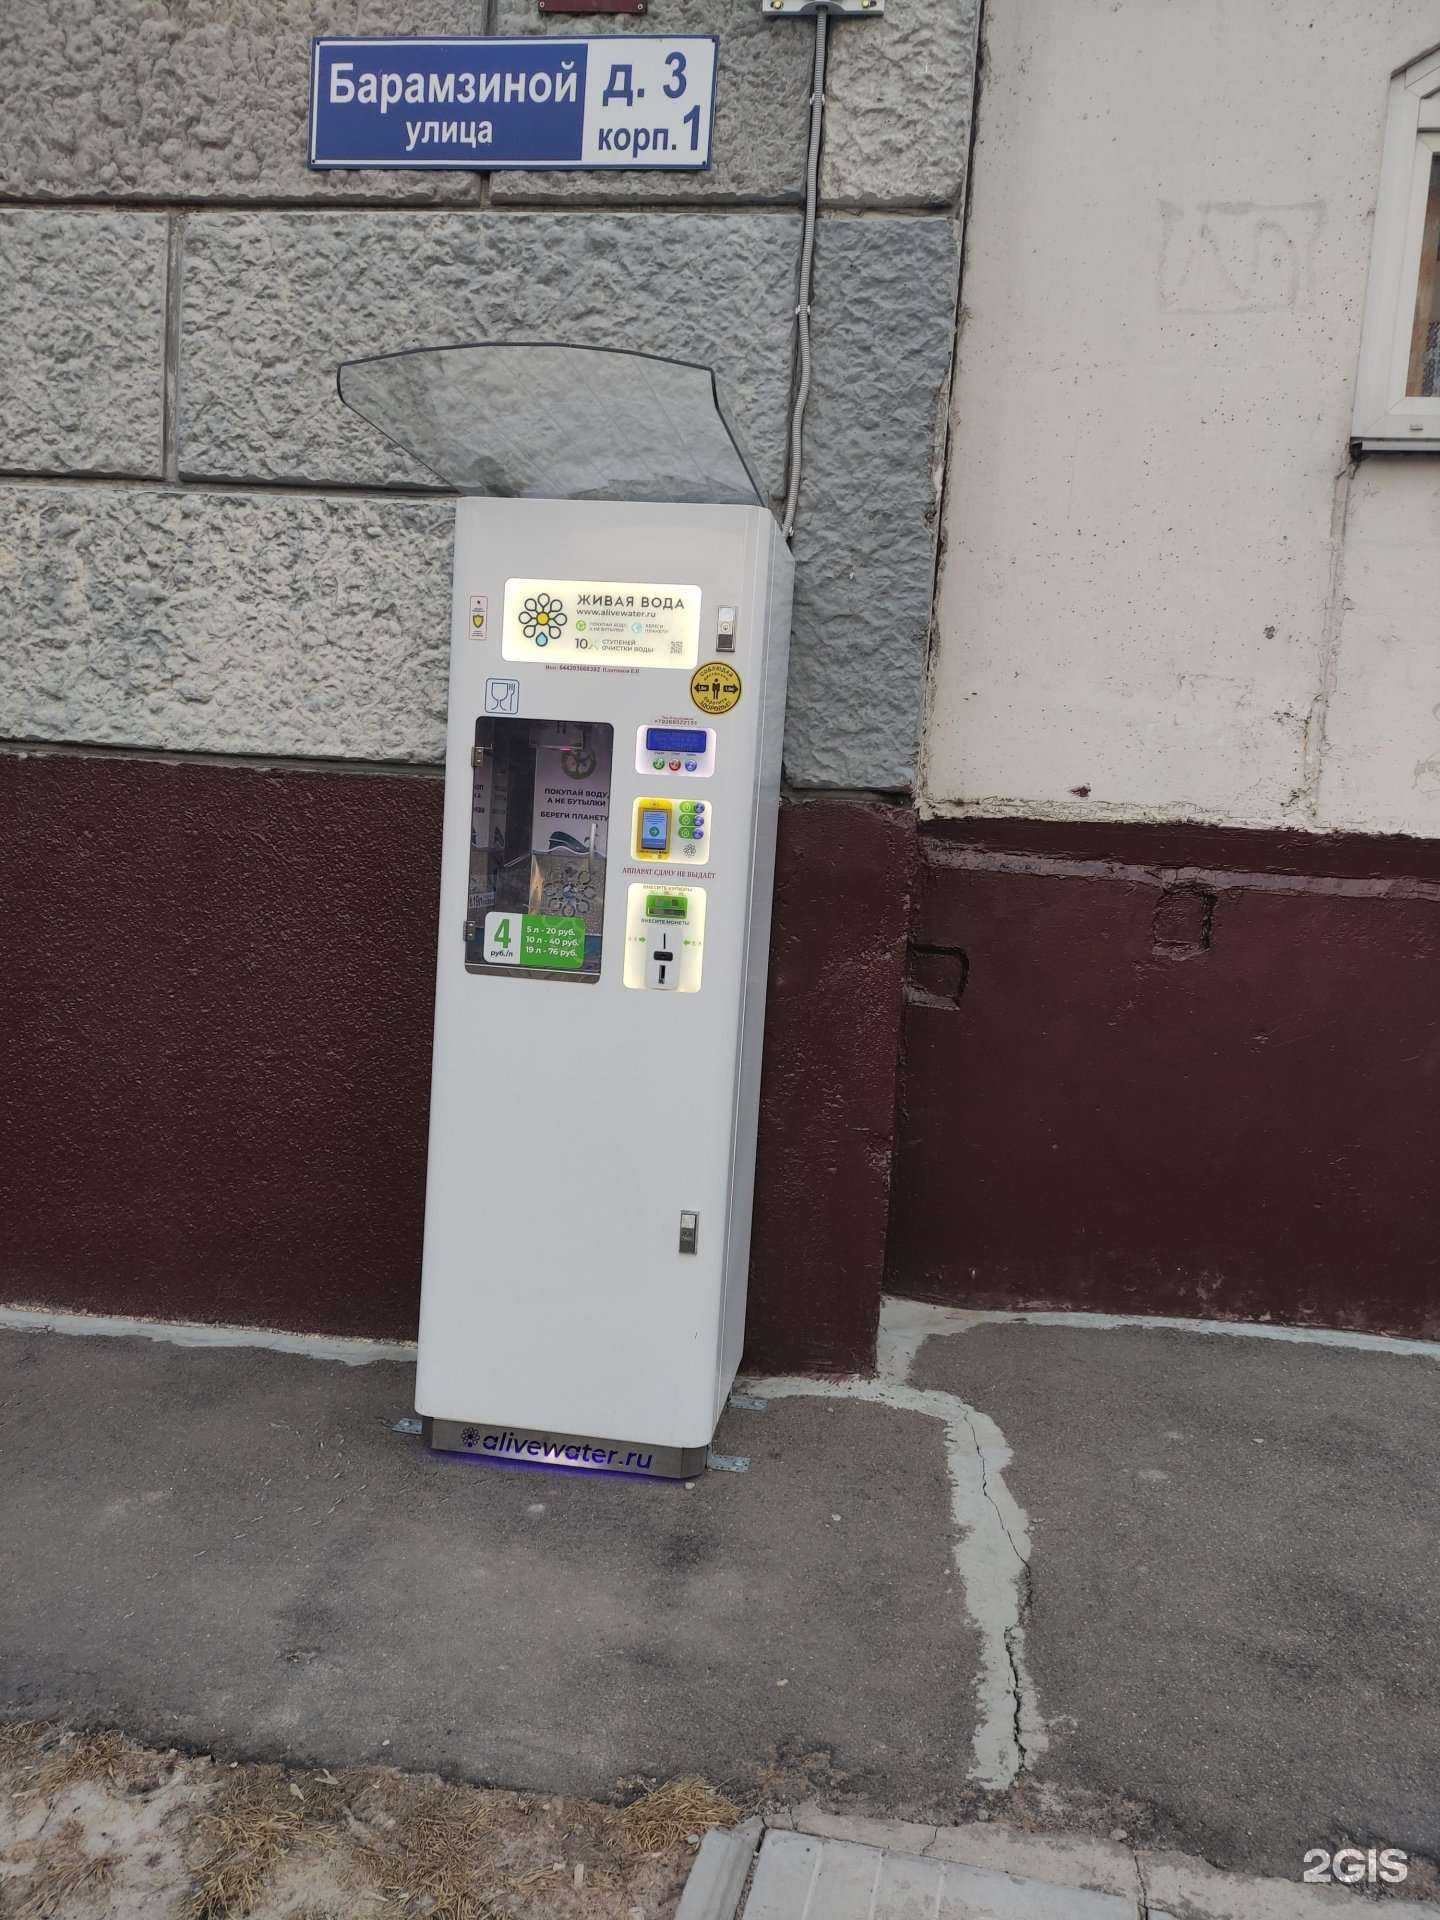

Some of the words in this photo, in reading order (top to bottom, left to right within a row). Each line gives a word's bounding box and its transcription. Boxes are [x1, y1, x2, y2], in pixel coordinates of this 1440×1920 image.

[602, 64, 645, 107] д.
[663, 51, 687, 98] 3
[329, 61, 578, 114] Барамзиной
[405, 121, 493, 151] улица
[577, 594, 635, 607] ЖИВАЯ
[641, 596, 685, 610] ВОДА
[576, 609, 656, 618] www.alivewater.ru
[544, 787, 583, 796] ПОКУПАЙ
[567, 798, 606, 806] БУТЫЛКИ
[571, 813, 609, 822] ПЛАНЕТУ
[494, 918, 511, 949] 4
[526, 925, 531, 933] 5
[558, 928, 575, 936] руб.
[526, 935, 535, 943] 10
[561, 939, 579, 947] руб.
[548, 947, 558, 955] 76
[560, 949, 577, 957] руб.
[483, 1432, 653, 1469] alivewater.ru
